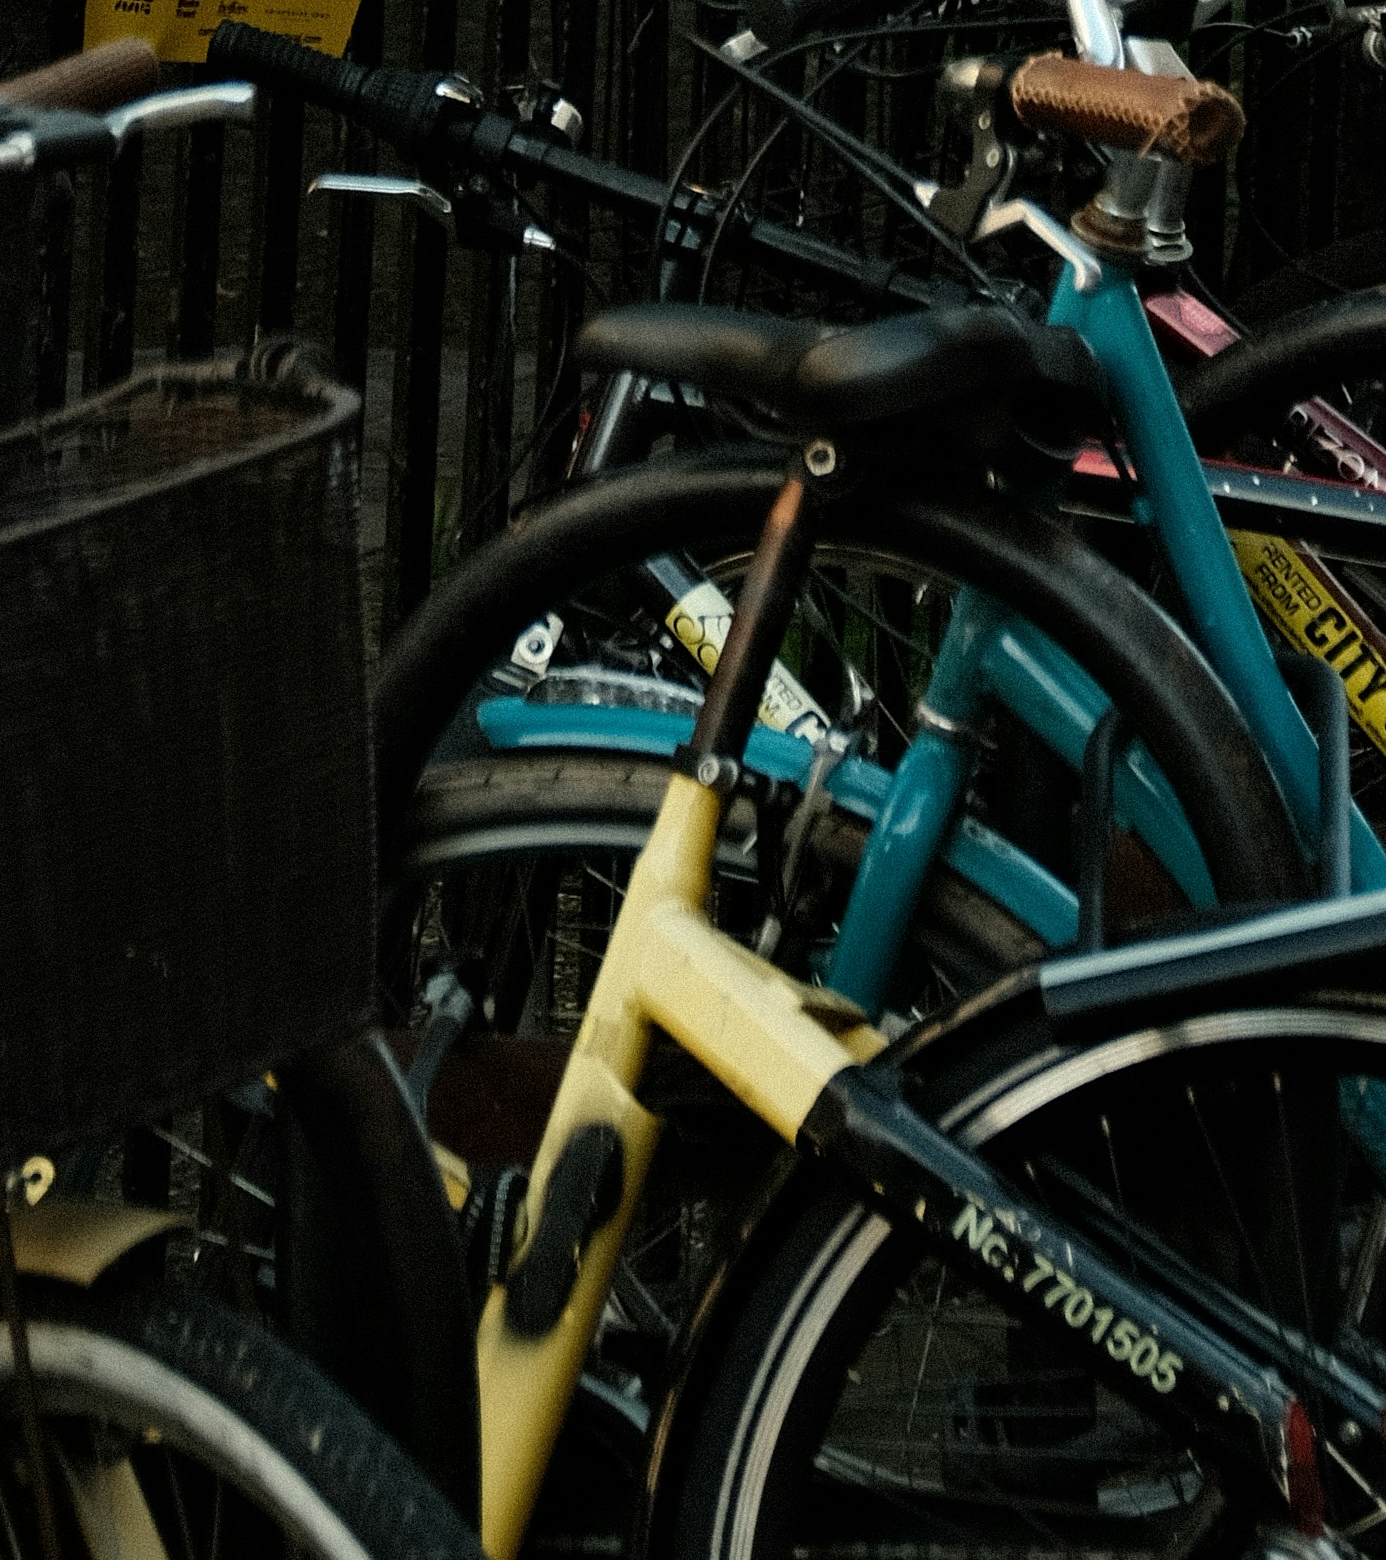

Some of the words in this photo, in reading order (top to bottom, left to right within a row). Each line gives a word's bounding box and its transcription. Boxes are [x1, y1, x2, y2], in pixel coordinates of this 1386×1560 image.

[1255, 564, 1299, 616] FROM
[1263, 544, 1322, 610] RENTED
[1023, 1253, 1184, 1393] 7701505
